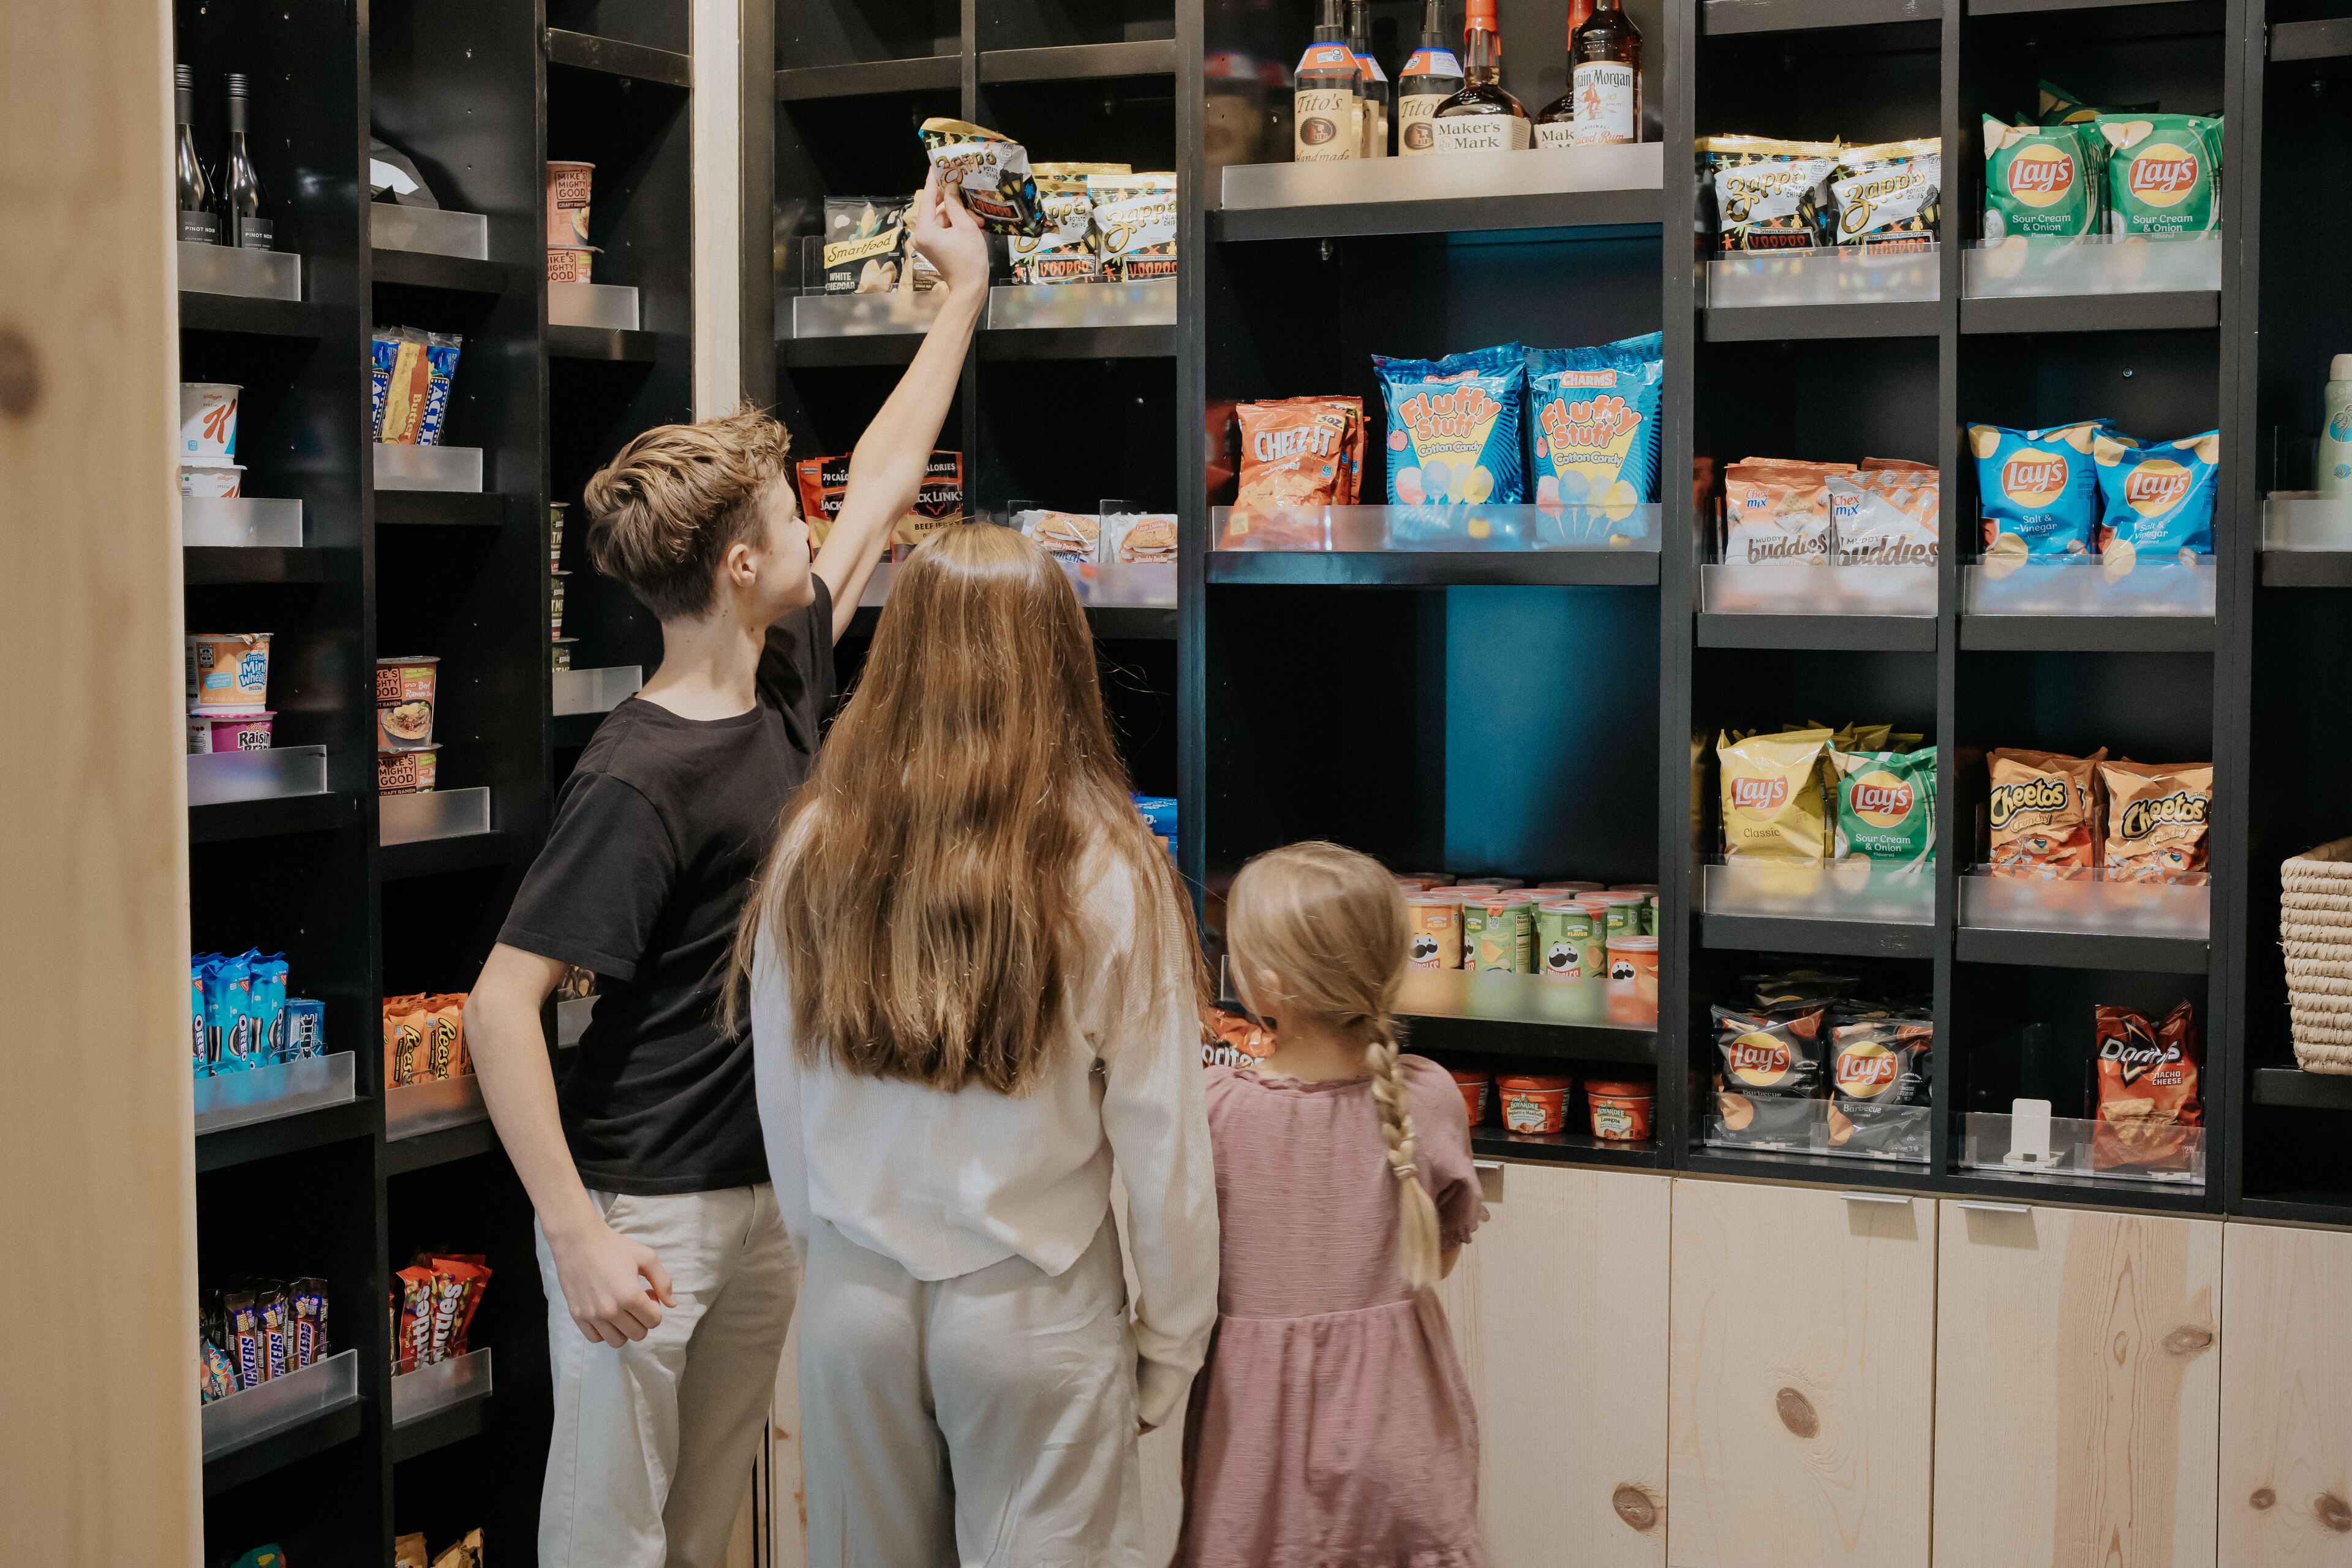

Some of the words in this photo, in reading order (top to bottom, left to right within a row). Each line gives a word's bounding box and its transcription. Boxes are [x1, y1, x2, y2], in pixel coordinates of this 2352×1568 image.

[1593, 69, 1630, 88] Morgan
[1298, 93, 1343, 113] Tito's
[1439, 123, 1500, 135] Maker's
[1455, 137, 1499, 149] Mark
[1599, 131, 1624, 143] Rum
[558, 170, 586, 180] MIKE'S
[2012, 156, 2070, 193] Lay's
[2133, 156, 2193, 193] Lay's
[559, 189, 586, 198] GOOD
[2012, 214, 2035, 223] Sour
[2133, 215, 2156, 224] Sour
[2153, 223, 2182, 232] Onion
[828, 234, 892, 262] Smartfood
[1749, 235, 1806, 248] VOODOO
[548, 254, 574, 263] IKE'S
[1040, 261, 1089, 277] VOODOO
[829, 273, 851, 281] WHITE
[826, 282, 855, 291] CHEDDAR
[1564, 373, 1613, 386] CHARMS
[1398, 386, 1502, 429] Fluffy
[203, 398, 236, 443] K
[405, 393, 422, 439] Butter
[1540, 394, 1643, 435] Fluffy
[1416, 415, 1476, 440] Stuff
[1553, 421, 1615, 449] Stuff
[1254, 426, 1335, 462] CHEEZ-IT
[1417, 443, 1452, 457] Cotton
[1453, 441, 1482, 454] Candy
[1553, 453, 1589, 466] Cotton
[1590, 451, 1623, 467] Candy
[2008, 460, 2064, 494] Lay's
[1745, 489, 1769, 500] Chex
[2130, 472, 2189, 505] Lay's
[1747, 498, 1770, 508] mix
[1834, 495, 1860, 506] Chex
[1836, 504, 1860, 516] mix
[2023, 514, 2042, 524] Salt
[2020, 523, 2057, 533] Vinegar
[2140, 522, 2155, 531] Salt
[1847, 535, 1880, 545] MUDDY
[2135, 530, 2168, 540] Vinegar
[1748, 533, 1828, 564] buddies
[242, 659, 266, 674] Mini
[239, 673, 266, 687] Wheats
[405, 690, 426, 698] Ramen
[239, 731, 270, 747] Raisin
[379, 756, 413, 767] MIKE'S
[379, 766, 413, 776] MIGHTY
[380, 774, 414, 785] GOOD
[1735, 778, 1785, 810] Lay's
[1856, 785, 1908, 816] Lay's
[1991, 779, 2066, 828] Cheetos
[2122, 792, 2207, 839] Cheetos
[2010, 812, 2050, 833] Crunchy
[1744, 827, 1780, 838] Classic
[1856, 834, 1877, 844] Sour
[1880, 834, 1910, 844] Cream
[2146, 827, 2188, 846] Crunchy
[1874, 843, 1901, 851] Onion
[194, 1014, 206, 1063] OREO
[238, 1014, 249, 1063] OREO
[2100, 1038, 2180, 1062] Doritos
[1733, 1044, 1785, 1072] Lay's
[1840, 1054, 1895, 1085] Lay's
[1743, 1089, 1781, 1098] Barbecue
[1510, 1102, 1539, 1110] BOYARDEE
[1597, 1108, 1625, 1117] BOYARDEE
[1844, 1104, 1882, 1114] Barbecue
